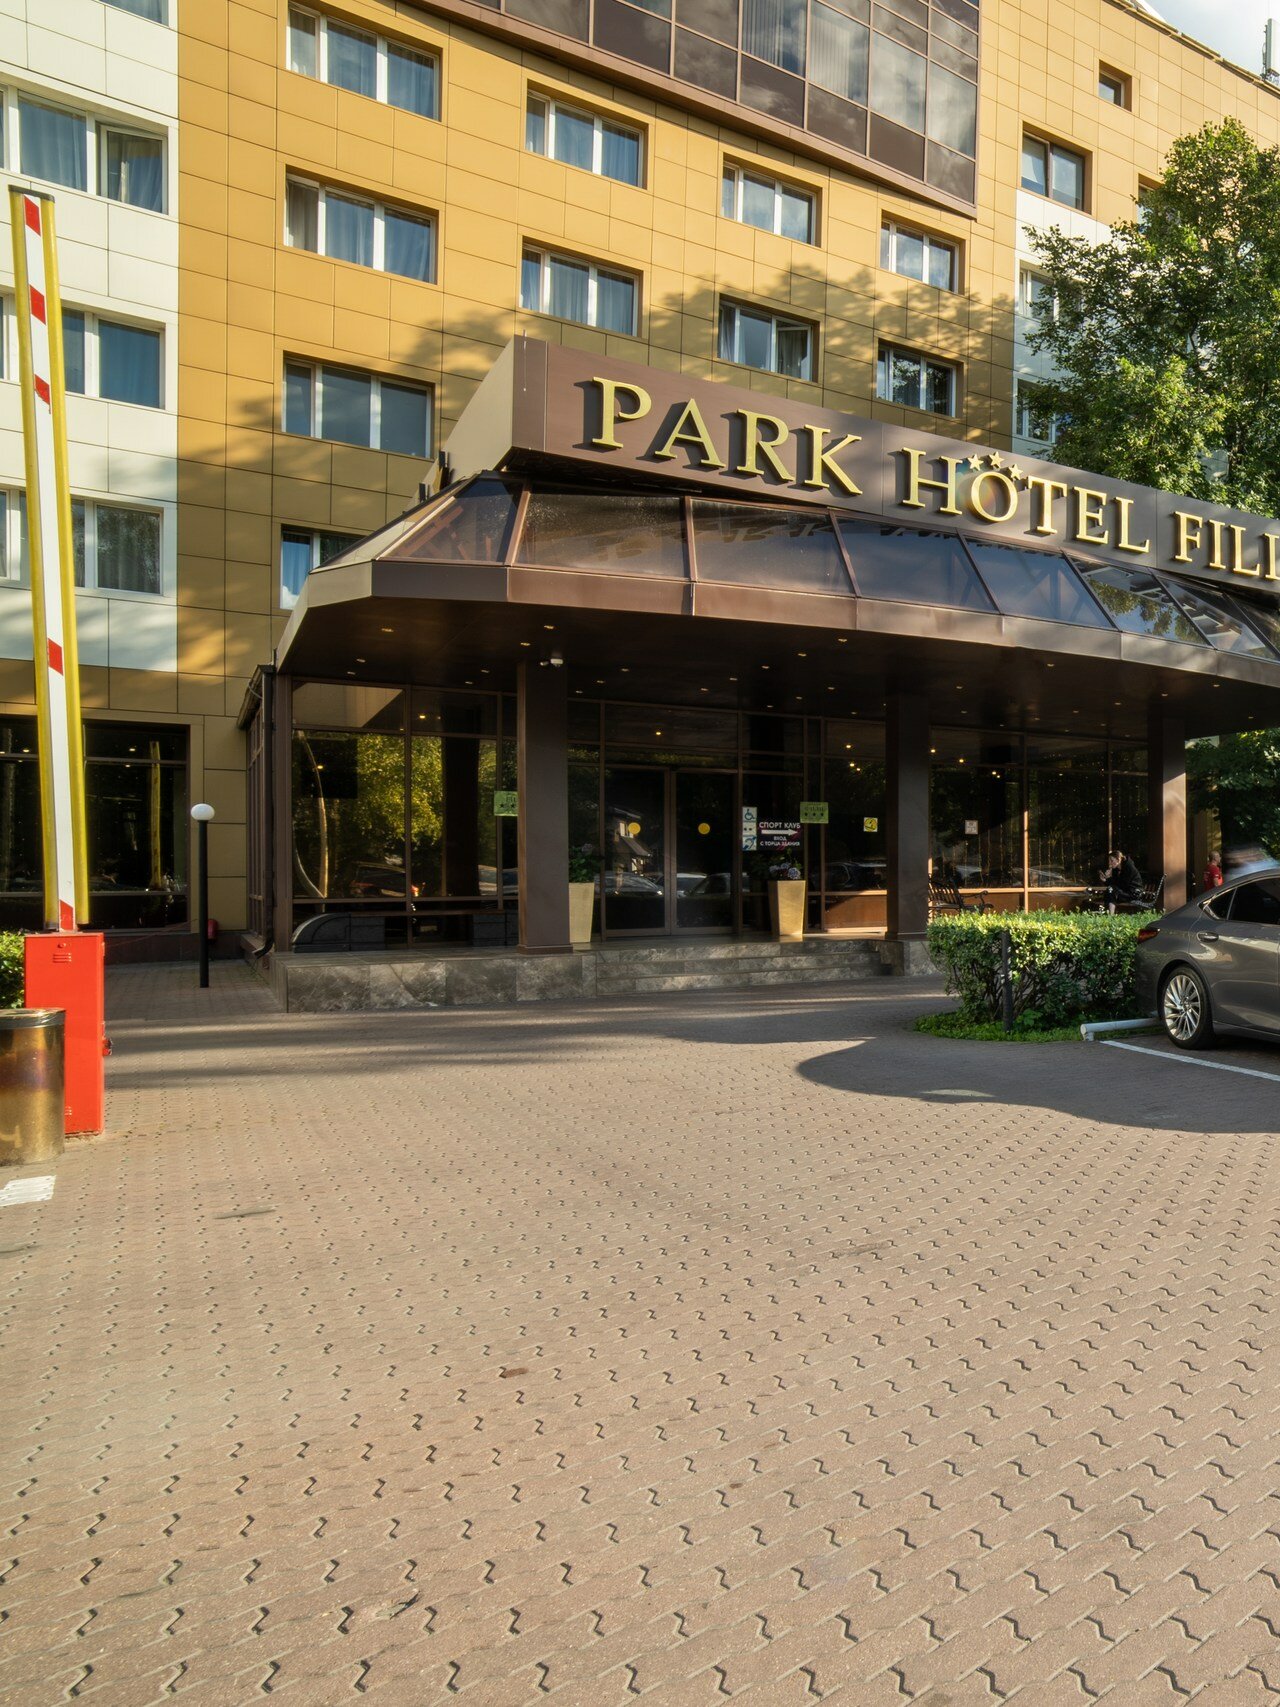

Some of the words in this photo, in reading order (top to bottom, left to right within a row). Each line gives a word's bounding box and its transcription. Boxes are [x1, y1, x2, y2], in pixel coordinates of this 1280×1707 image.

[592, 376, 863, 495] PARK
[901, 448, 1150, 554] HOTEL
[759, 821, 782, 829] СПОРТ
